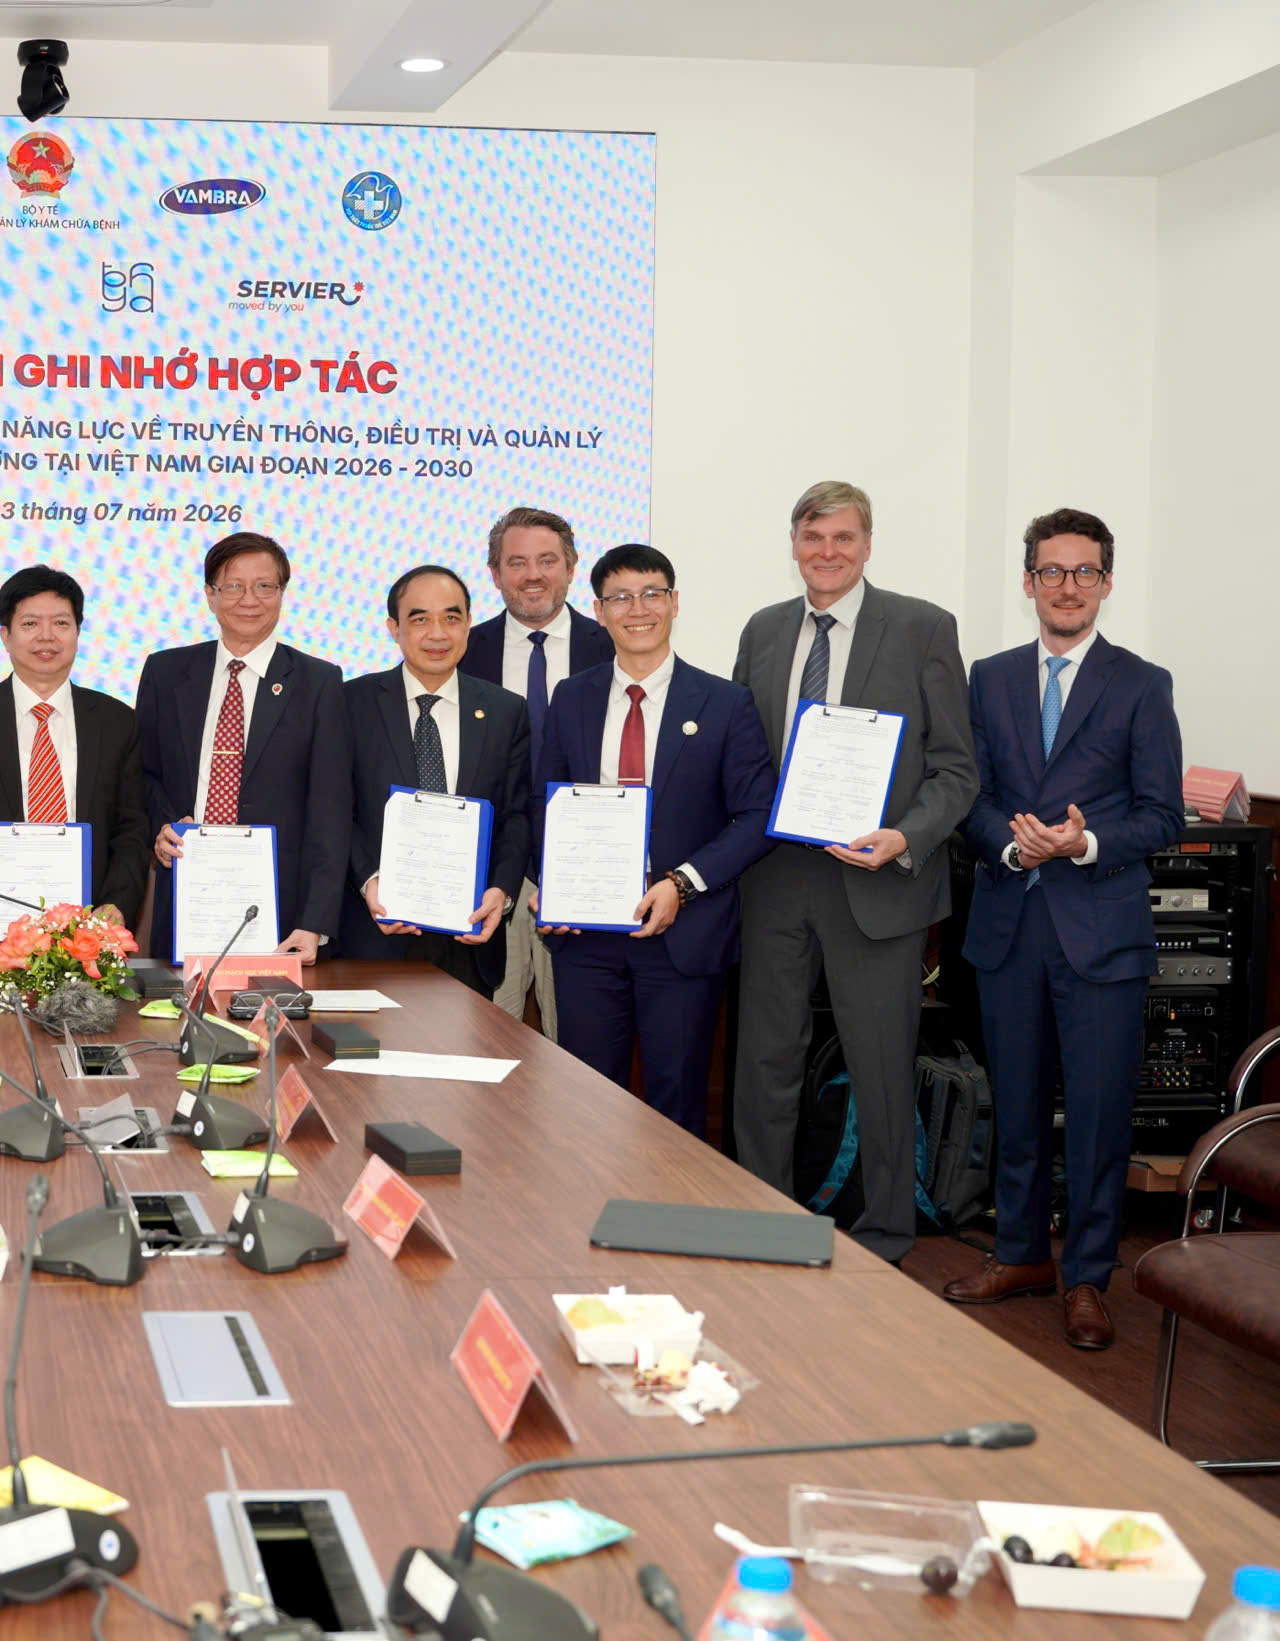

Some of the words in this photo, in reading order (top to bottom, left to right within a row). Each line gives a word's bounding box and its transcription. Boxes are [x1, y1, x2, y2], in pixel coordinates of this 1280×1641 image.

[174, 189, 252, 205] VAMBRA
[22, 204, 36, 216] BỘ
[38, 206, 45, 214] Y
[47, 203, 59, 215] TẾ
[29, 218, 59, 228] KHÁM
[93, 219, 120, 231] BỆNH
[237, 280, 358, 305] SERVIER
[228, 301, 265, 310] moved
[268, 302, 281, 313] by
[285, 303, 304, 313] you
[13, 354, 90, 388] GHI
[100, 347, 198, 390] NHỚ
[208, 354, 302, 400] HỢP
[310, 351, 398, 394] TÁC
[2, 416, 71, 439] NĂNG
[78, 419, 125, 444] LỰC
[131, 414, 162, 440] VỀ
[168, 415, 263, 442] TRUYỀN
[269, 420, 360, 448] THÔNG,
[366, 418, 419, 445] ĐIỀU
[426, 428, 461, 451] TRỊ
[467, 424, 499, 447] VÀ
[504, 425, 570, 448] QUẢN
[577, 426, 603, 449] LÝ
[44, 453, 80, 476] TẠI
[87, 449, 140, 477] VIỆT
[146, 454, 201, 473] NAM
[208, 455, 254, 474] GIAI
[260, 455, 328, 479] ĐOẠN
[334, 457, 392, 476] 2026
[414, 459, 473, 477] 2030
[21, 501, 88, 525] tháng
[94, 502, 123, 521] 07
[127, 503, 177, 522] năm
[183, 503, 243, 522] 2026
